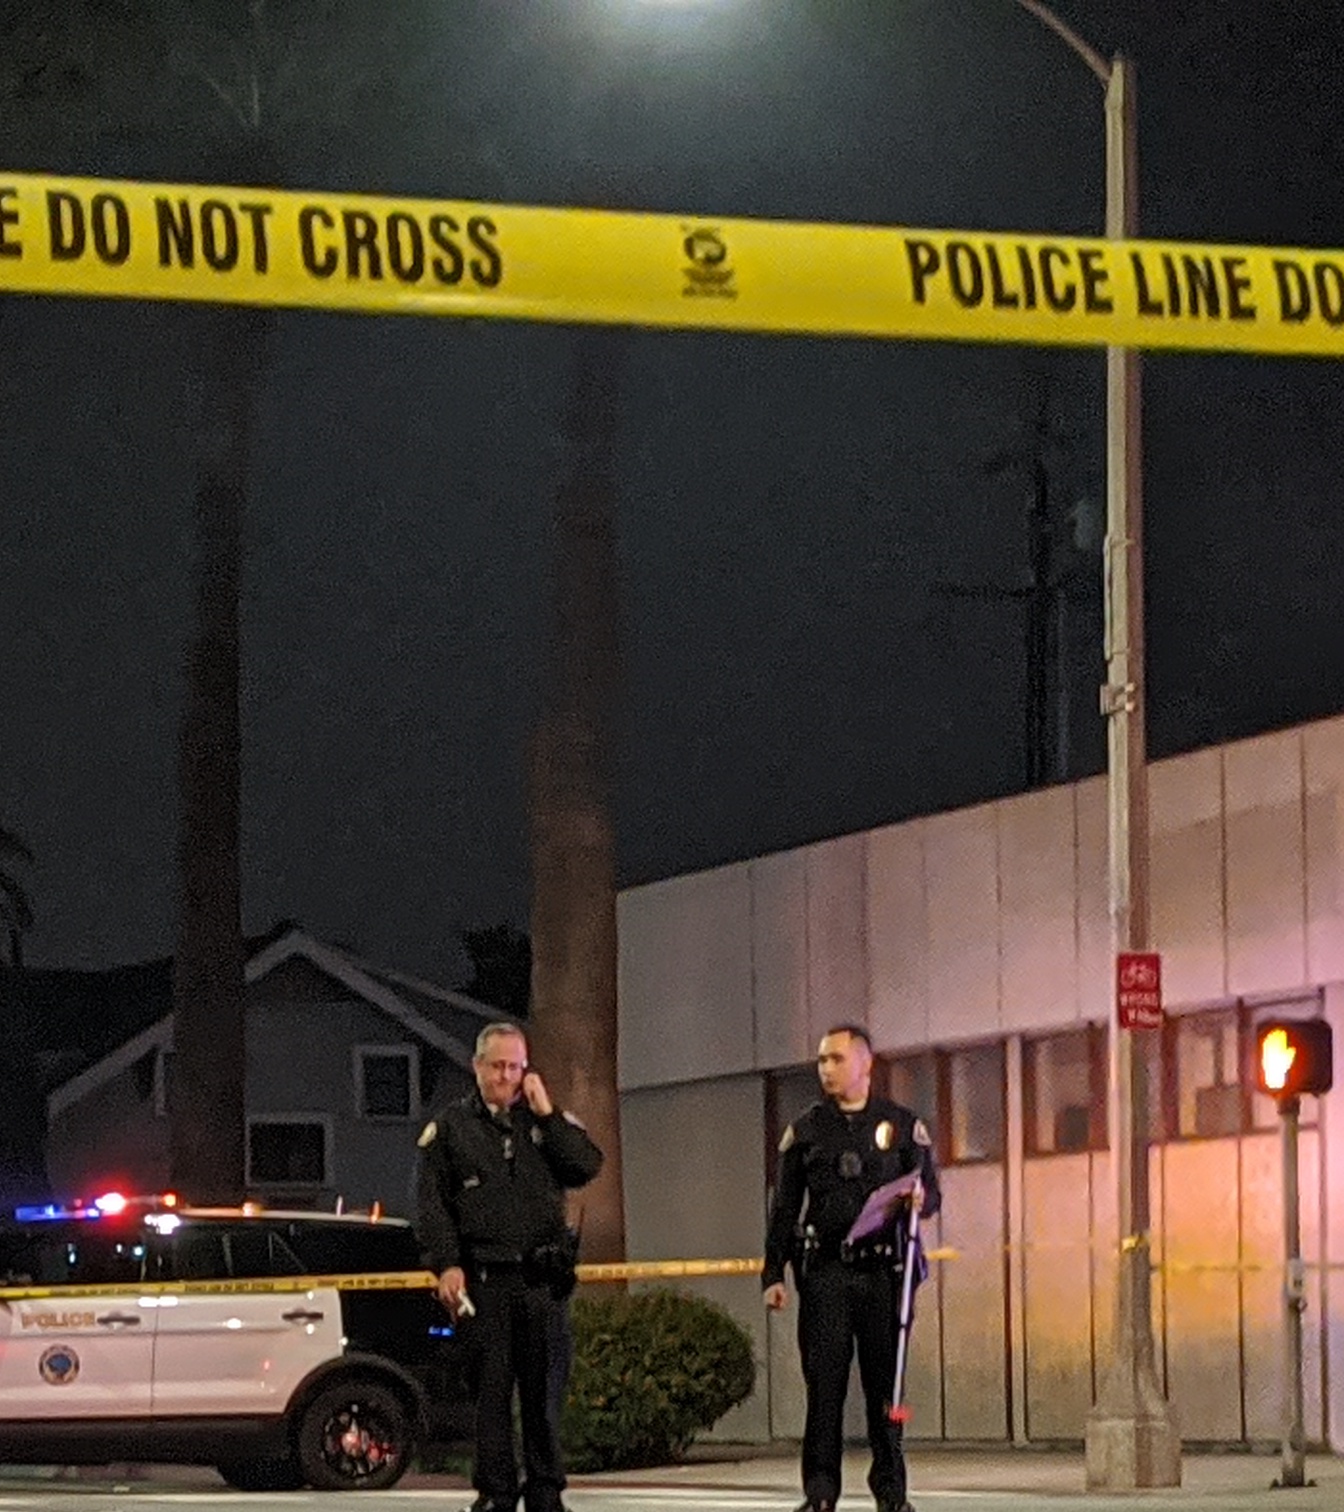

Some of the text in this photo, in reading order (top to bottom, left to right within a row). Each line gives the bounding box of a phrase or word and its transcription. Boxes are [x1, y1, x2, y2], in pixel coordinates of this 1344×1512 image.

[46, 189, 131, 266] DO
[154, 195, 273, 275] NOT
[298, 205, 504, 289] CROSS
[905, 239, 1114, 314] POLICE
[1129, 250, 1257, 321] LINE
[21, 1312, 96, 1329] POLICE
